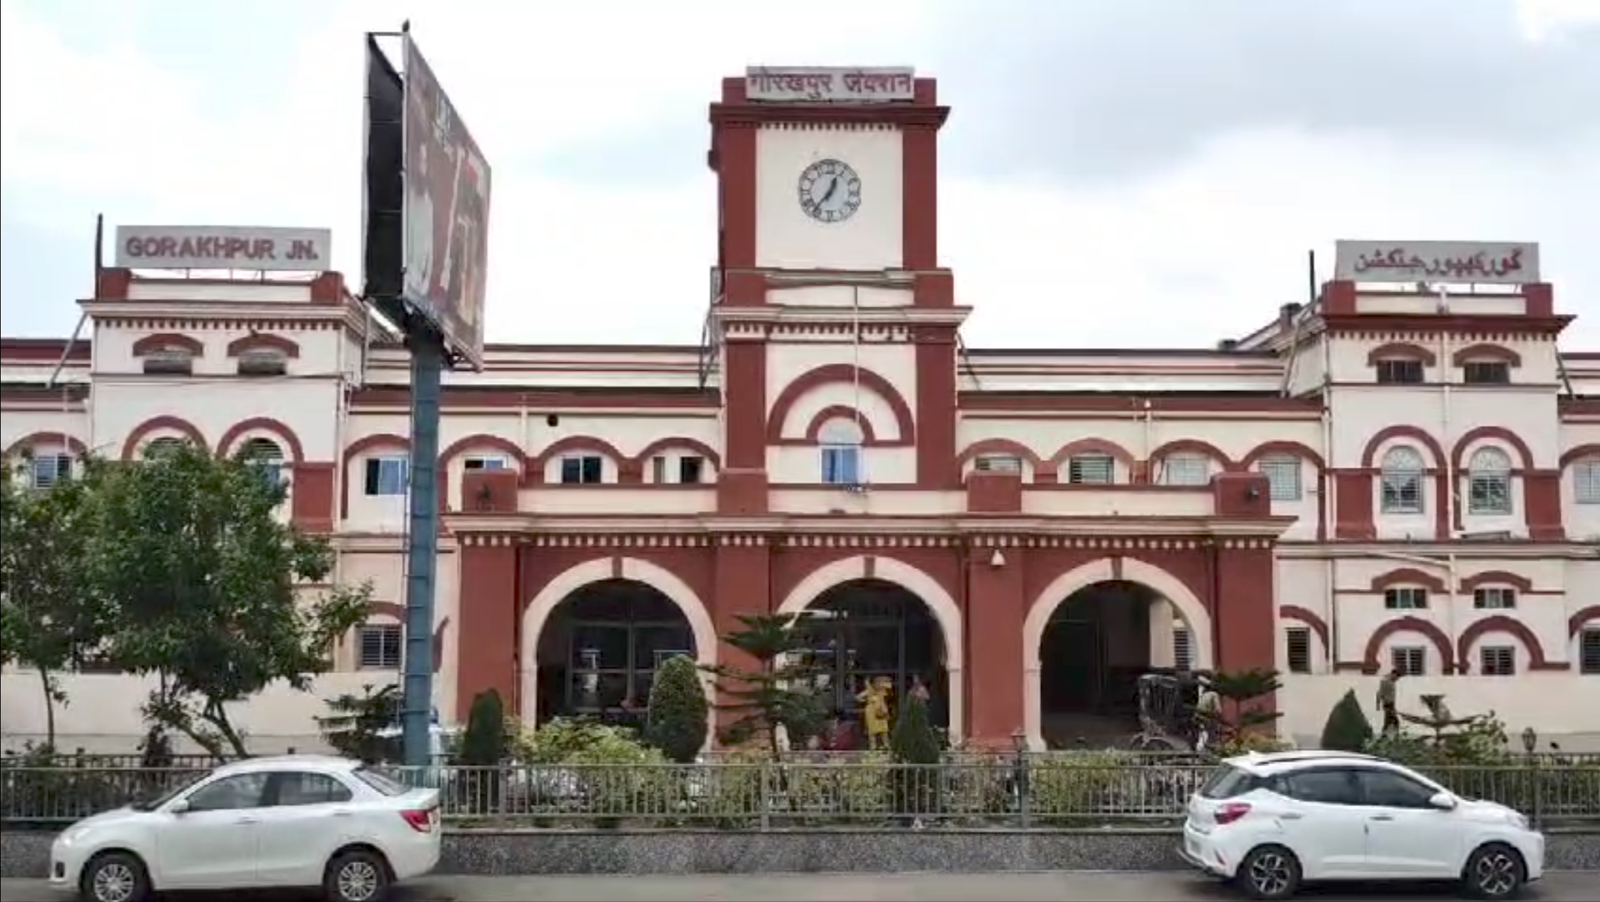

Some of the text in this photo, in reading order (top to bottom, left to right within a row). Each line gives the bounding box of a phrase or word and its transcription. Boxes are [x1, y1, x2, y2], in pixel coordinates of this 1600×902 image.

[748, 66, 832, 99] गोरखपुर
[125, 236, 319, 260] GORAKHPUR JN.
